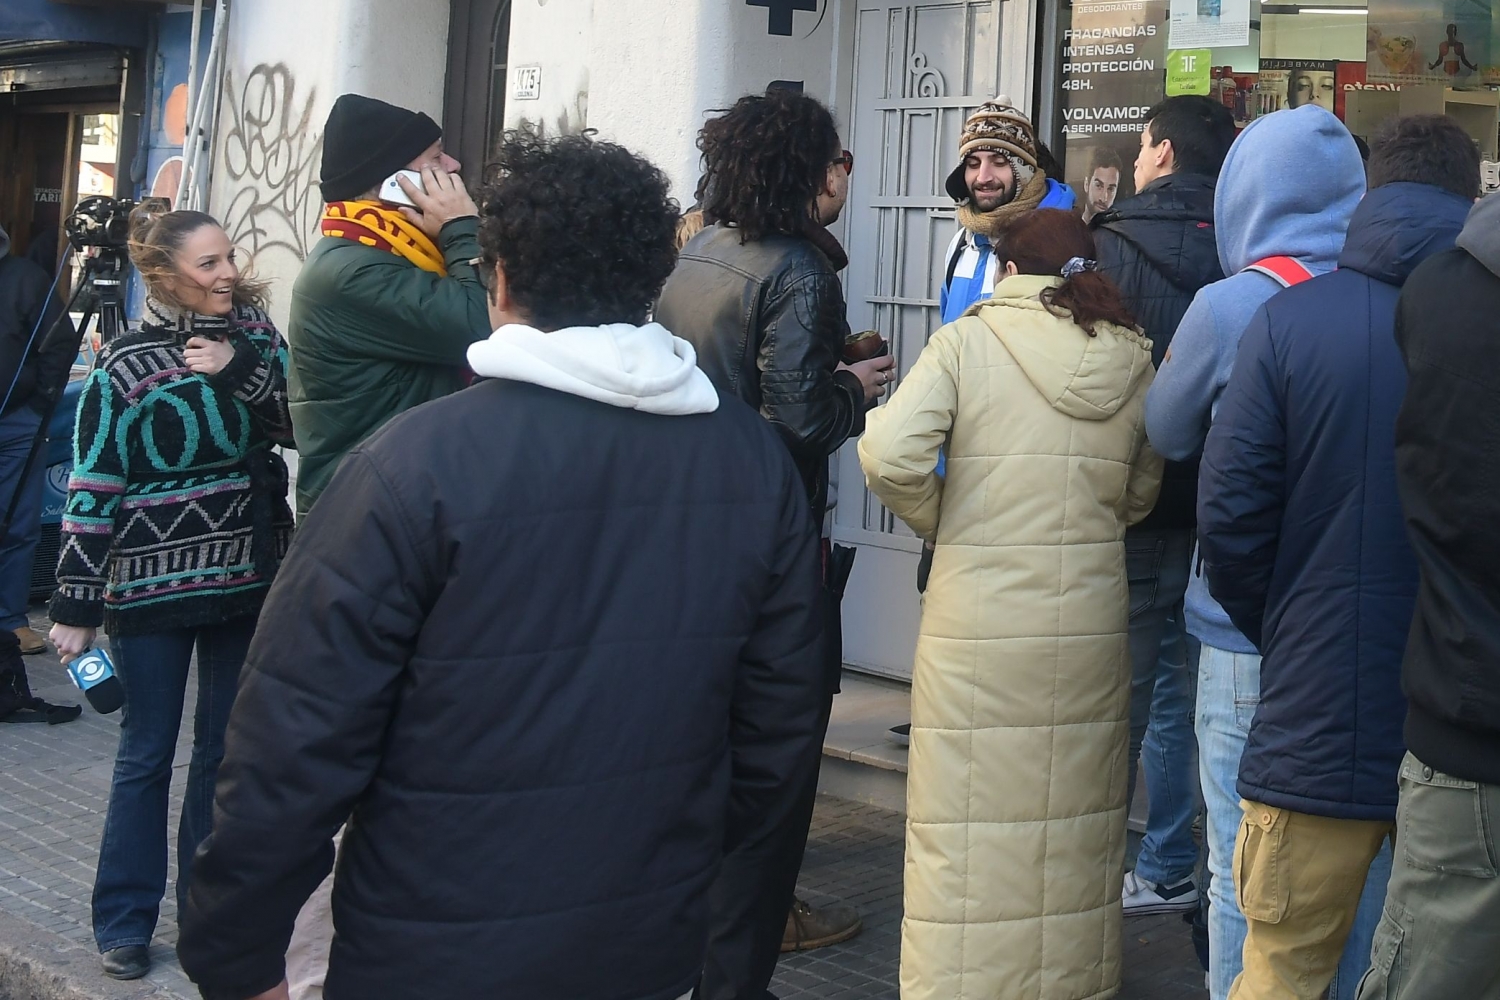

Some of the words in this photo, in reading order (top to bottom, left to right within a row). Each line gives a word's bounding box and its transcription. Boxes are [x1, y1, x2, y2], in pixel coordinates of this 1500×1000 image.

[1077, 2, 1143, 14] DESODORANTES
[1064, 25, 1157, 41] FRAGANCIAS
[1063, 43, 1135, 57] INTENSAS
[1062, 57, 1155, 74] PROTECCIÓN
[1061, 79, 1094, 91] 48H.
[1061, 124, 1070, 133] A
[1071, 124, 1093, 133] SER
